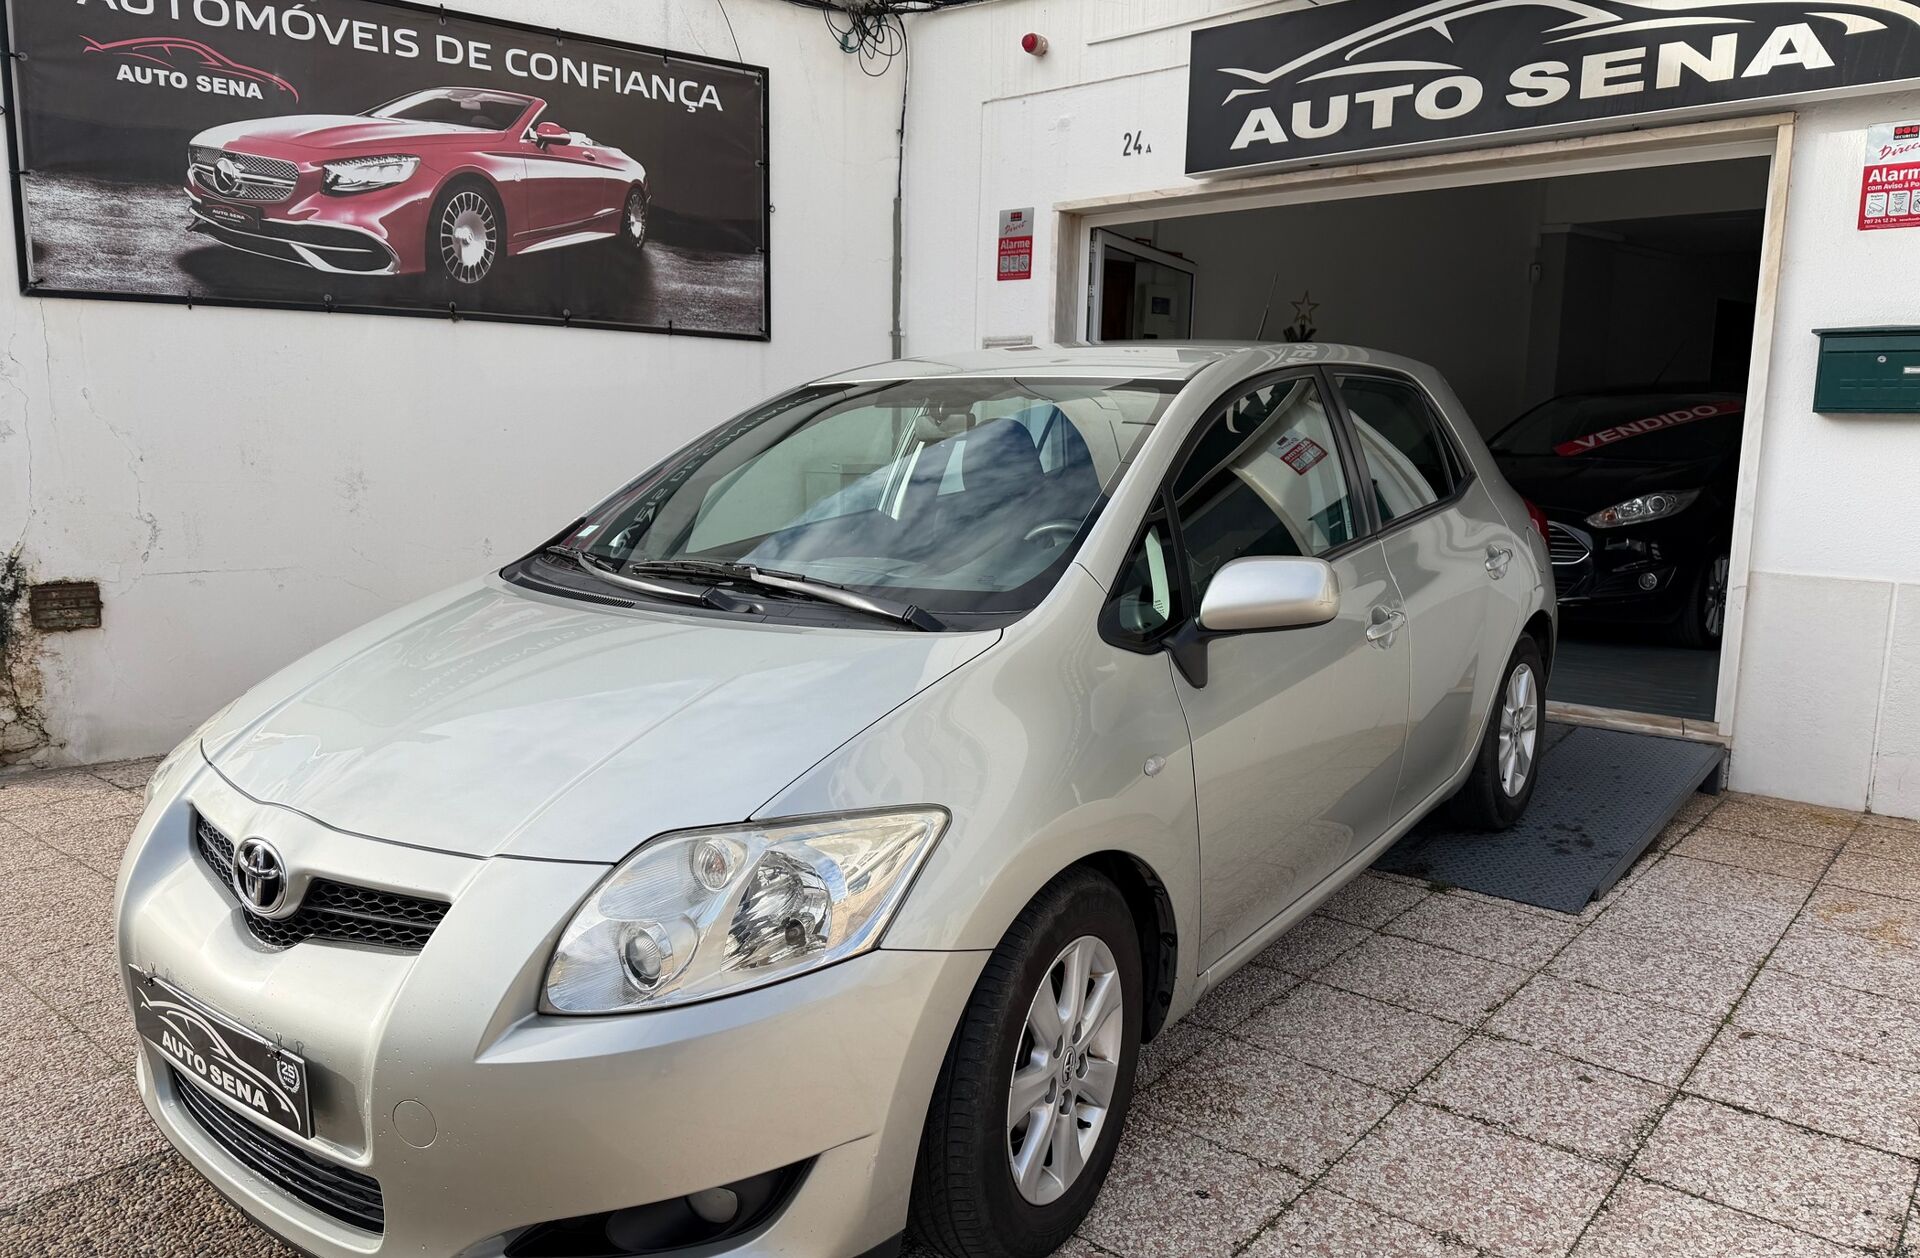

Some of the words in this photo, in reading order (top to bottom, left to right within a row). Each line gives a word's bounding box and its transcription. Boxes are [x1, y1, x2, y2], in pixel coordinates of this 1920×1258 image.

[117, 63, 188, 89] AUTO
[196, 75, 264, 100] SENA
[436, 34, 492, 71] DE
[505, 47, 724, 113] CONFIANÇA
[1230, 75, 1484, 150] AUTO
[1505, 22, 1836, 108] SENA
[1123, 130, 1142, 156] 24
[1001, 239, 1030, 249] Alarme
[1573, 405, 1718, 448] VENDIDO
[162, 1030, 207, 1076] AUTO
[209, 1064, 270, 1113] SENA
[281, 1061, 295, 1079] 25
